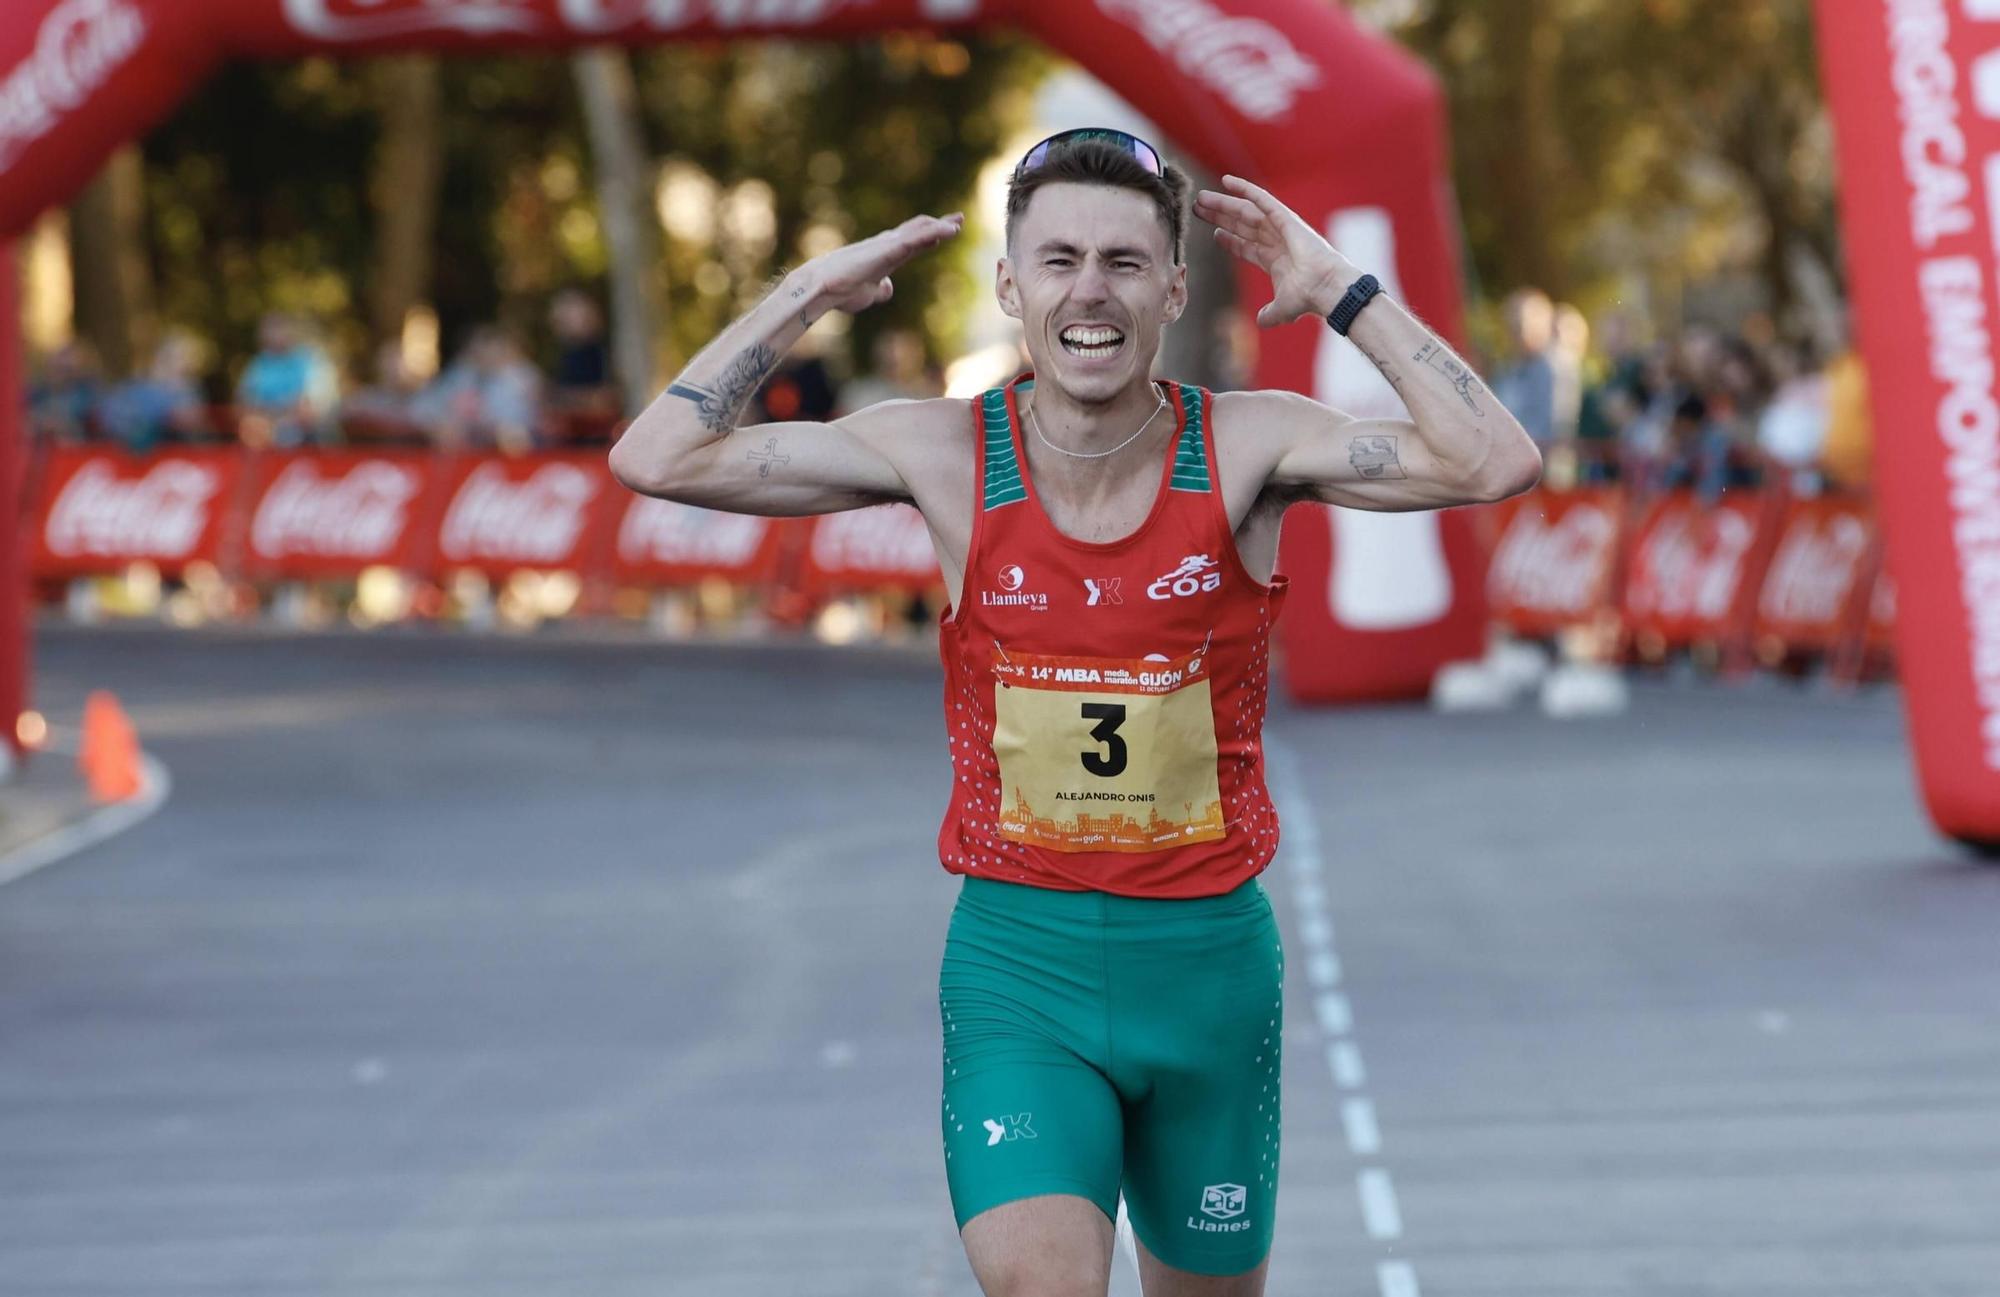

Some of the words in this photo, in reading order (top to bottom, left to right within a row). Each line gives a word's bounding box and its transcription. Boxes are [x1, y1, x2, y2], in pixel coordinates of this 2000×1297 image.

[981, 591, 1048, 606] Llamieva
[1055, 668, 1102, 683] MBA
[1104, 669, 1130, 677] media
[1104, 676, 1138, 685] maratón
[1139, 670, 1182, 686] GIJÓN
[1080, 702, 1128, 778] 3
[1055, 792, 1125, 802] ALEJANDRO
[1127, 793, 1156, 803] ONIS
[1187, 1216, 1251, 1232] Llanes
